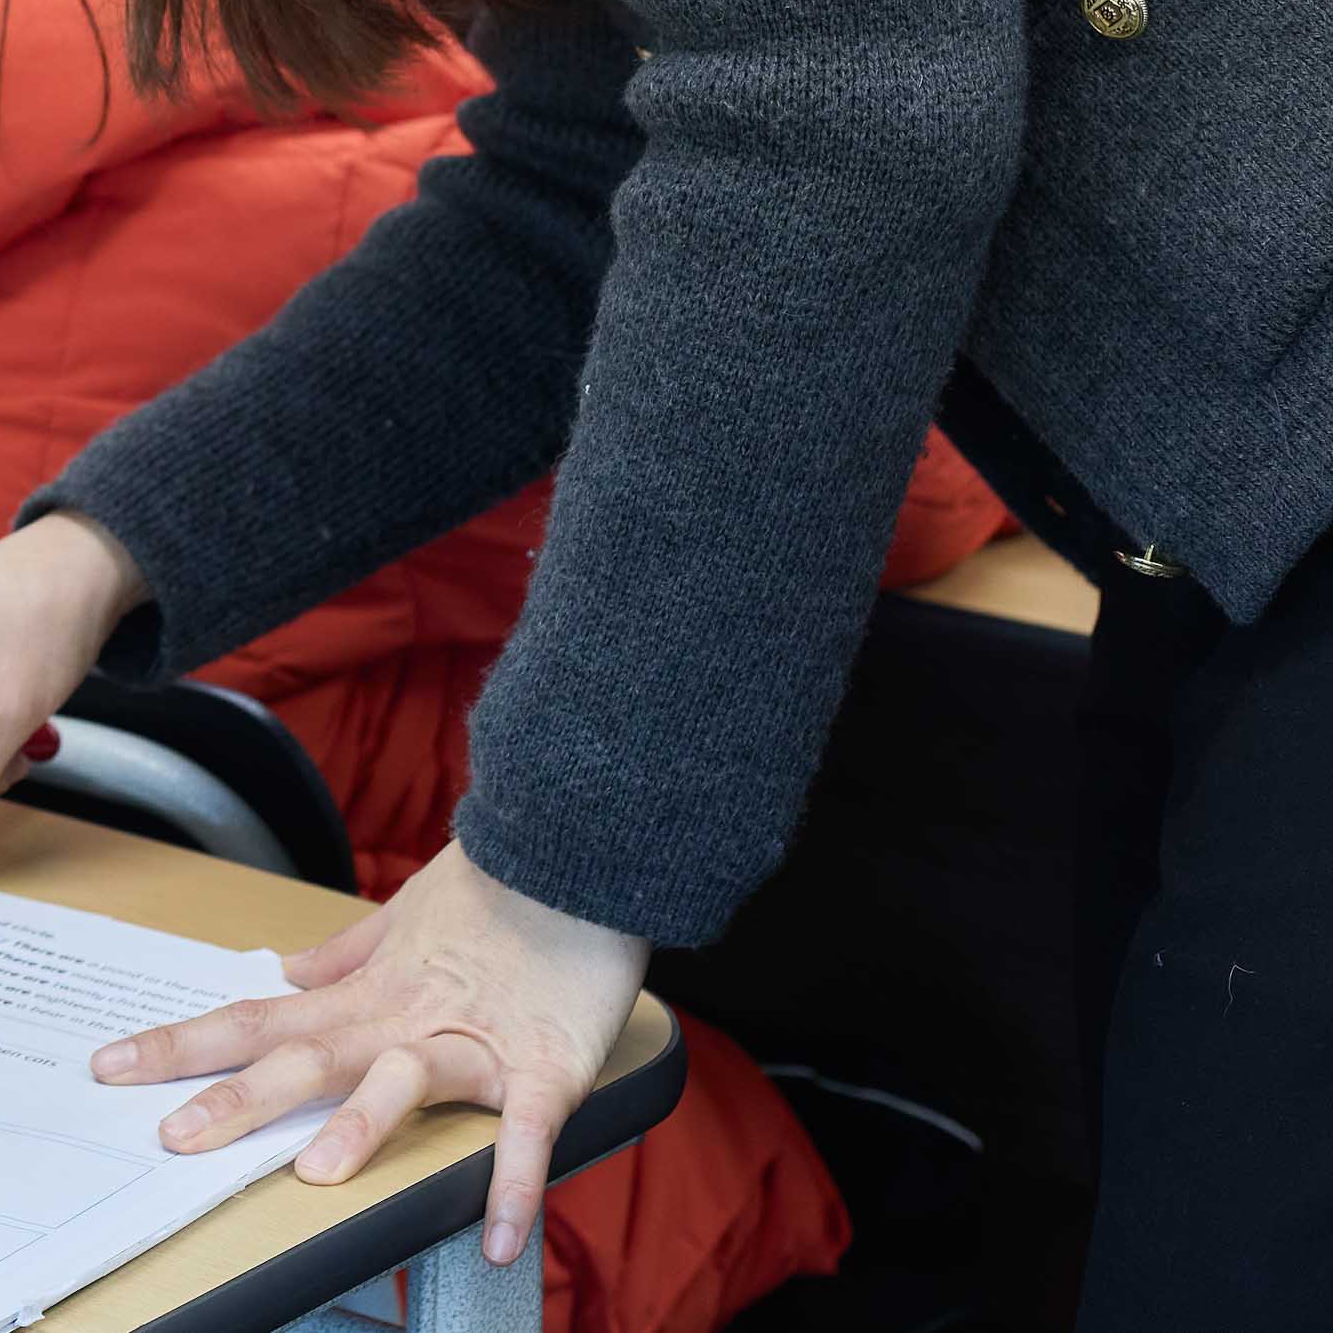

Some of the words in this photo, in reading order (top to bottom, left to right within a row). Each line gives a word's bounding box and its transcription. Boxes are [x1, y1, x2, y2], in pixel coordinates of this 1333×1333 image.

[13, 940, 55, 956] There
[58, 954, 85, 964] are
[40, 964, 67, 974] are
[22, 974, 50, 984] are
[4, 985, 32, 995] are
[23, 1054, 59, 1068] cats
